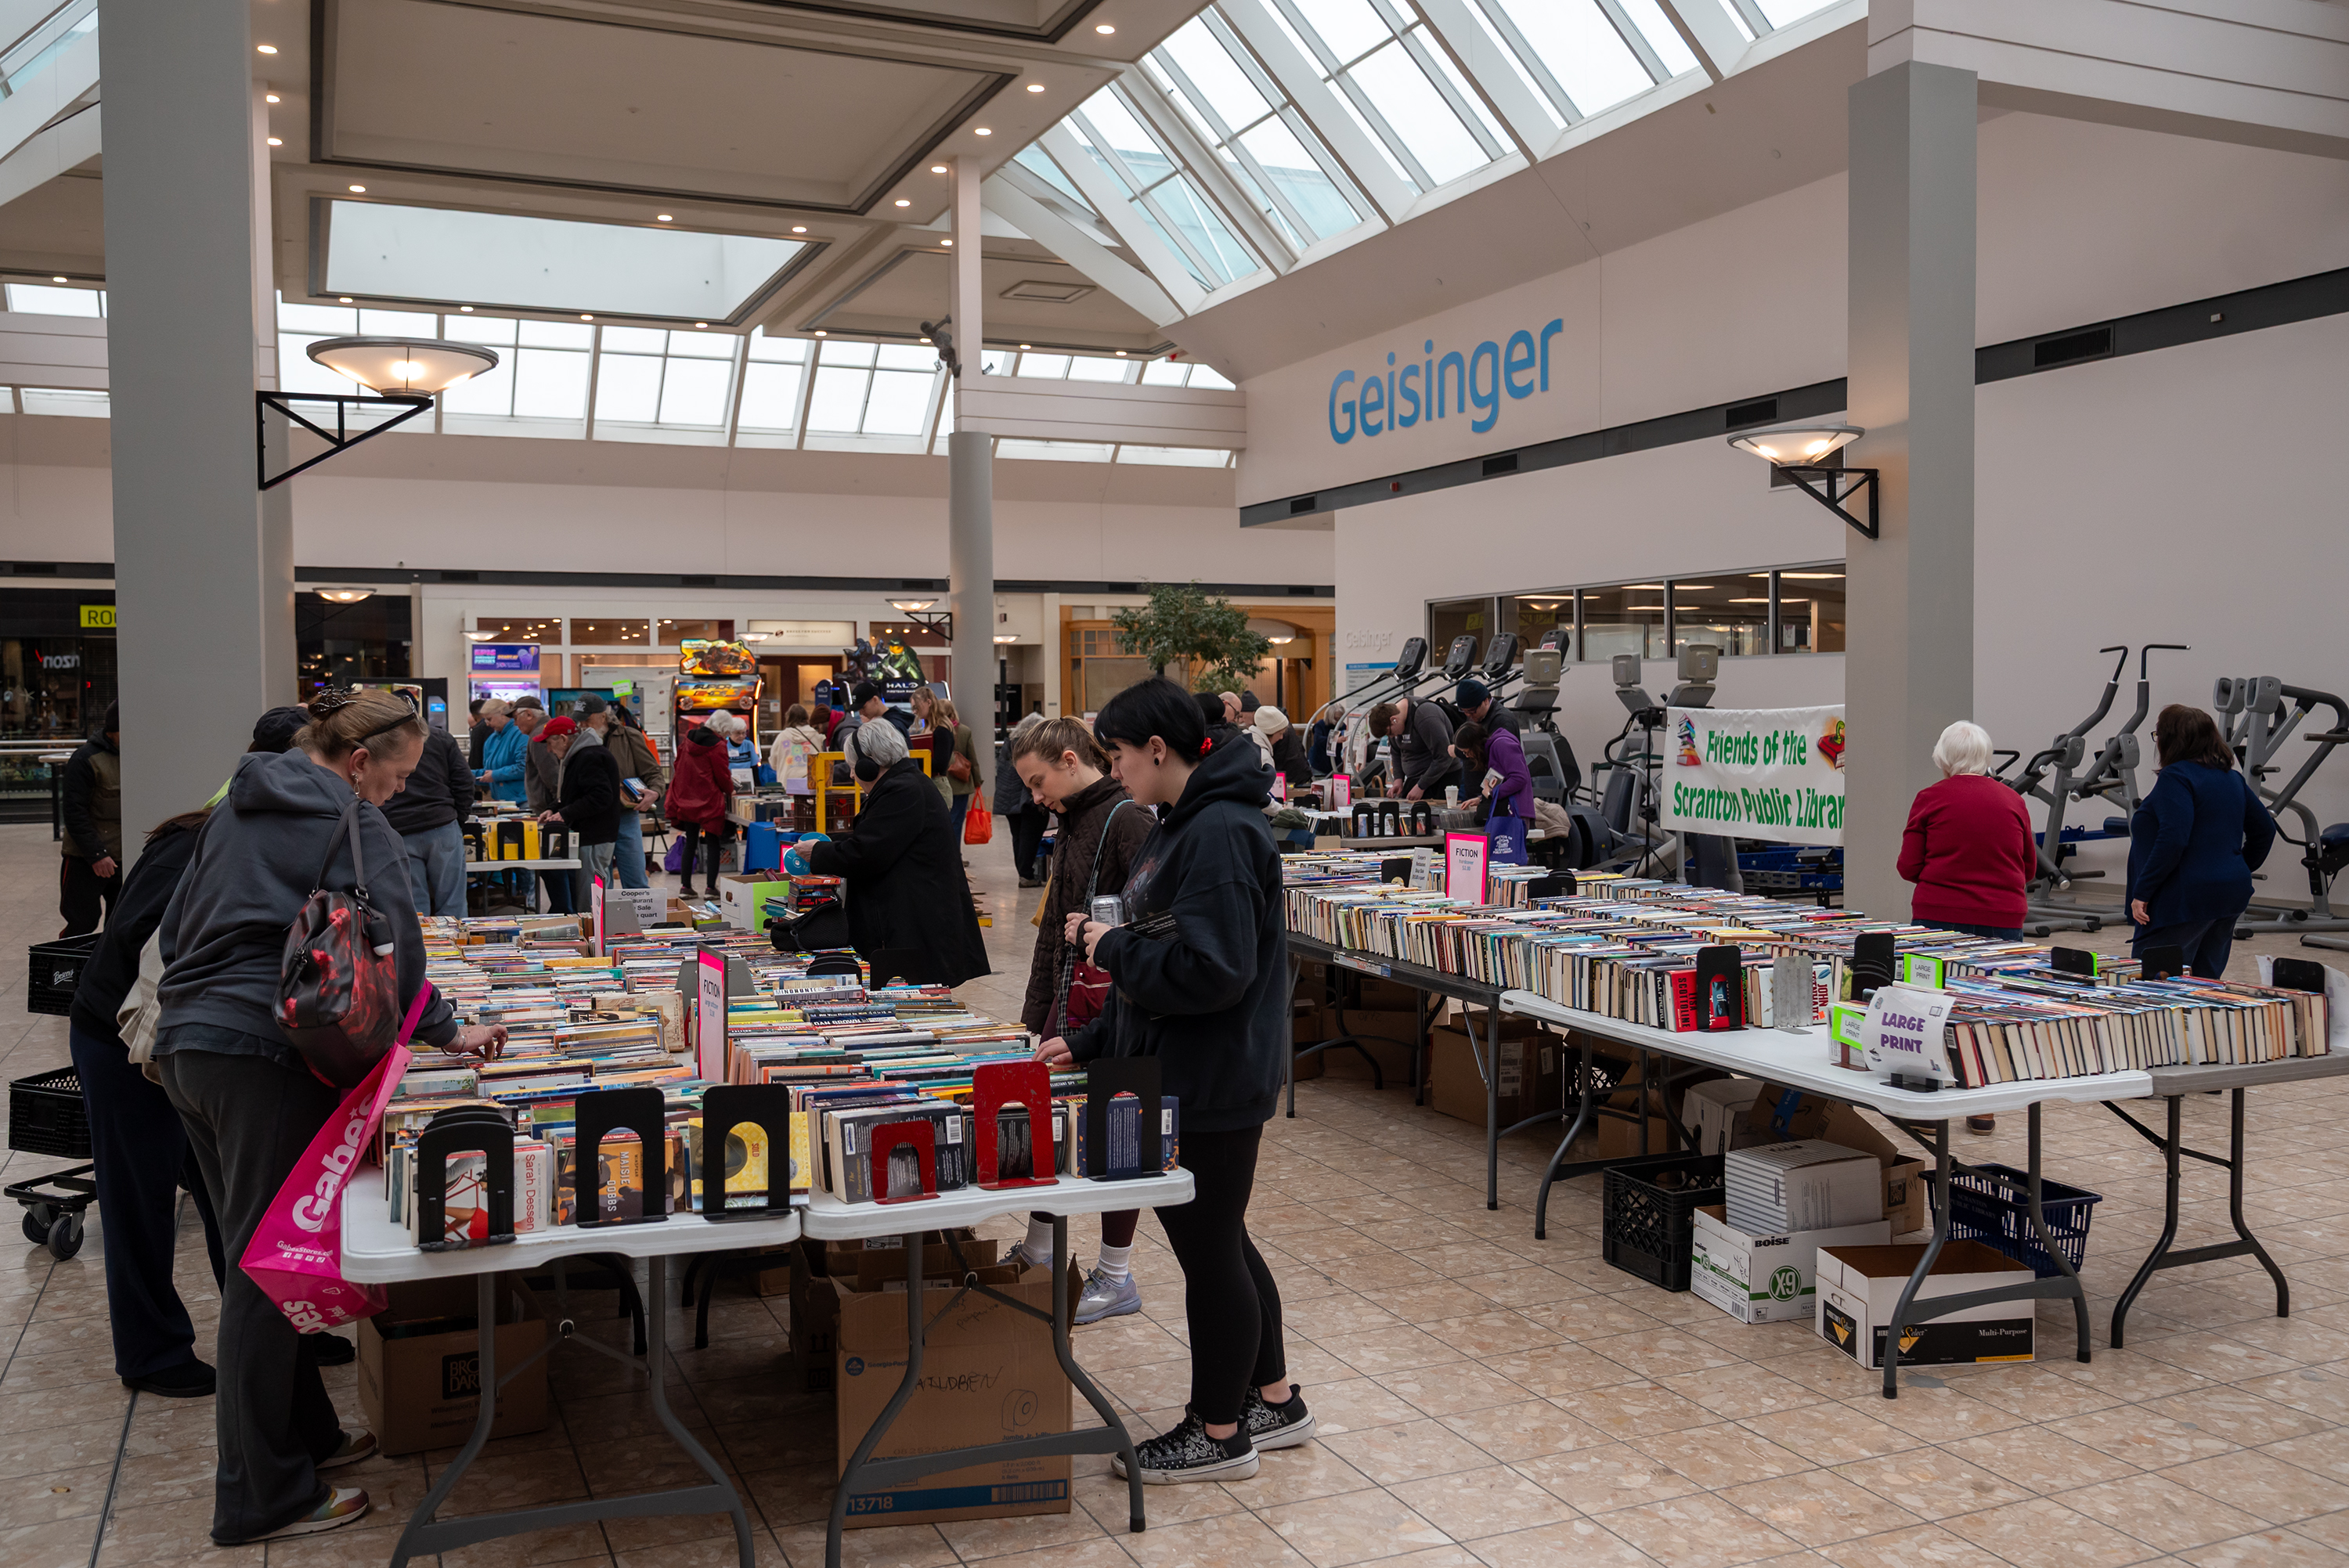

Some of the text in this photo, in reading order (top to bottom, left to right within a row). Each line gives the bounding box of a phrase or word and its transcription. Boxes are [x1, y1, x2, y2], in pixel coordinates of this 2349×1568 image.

[1329, 318, 1563, 445] Geisinger
[1345, 629, 1393, 651] Geisinger
[1705, 730, 1807, 766] Friends of the
[1673, 780, 1845, 829] Scranton Public Librar
[1456, 848, 1478, 858] FICTION
[1915, 964, 1931, 972] LARGE
[703, 979, 720, 999] FICTION
[1817, 983, 1828, 1007] JOHN
[1678, 978, 1690, 1028] SCOTTOLINE
[1845, 1020, 1860, 1031] LARGE
[1881, 1011, 1926, 1033] LARGE
[1846, 1029, 1860, 1039] PRINT
[1881, 1033, 1923, 1054] PRINT
[751, 1143, 760, 1157] SOLD
[292, 1092, 374, 1233] Gabe's
[619, 1151, 630, 1185] MAISIE
[525, 1154, 536, 1231] Sarah Dessen
[606, 1180, 617, 1212] DOBBS
[1890, 1183, 1903, 1194] BRO
[1890, 1192, 1903, 1203] DART
[1950, 1199, 1996, 1219] PUBLIC LIBRARY
[1958, 1194, 1987, 1208] SCRANTON
[1905, 1326, 1925, 1340] Select
[1979, 1328, 2027, 1337] Multi-Purpose
[449, 1357, 479, 1377] BRO
[449, 1373, 479, 1393] DAR
[849, 1496, 893, 1512] 13718
